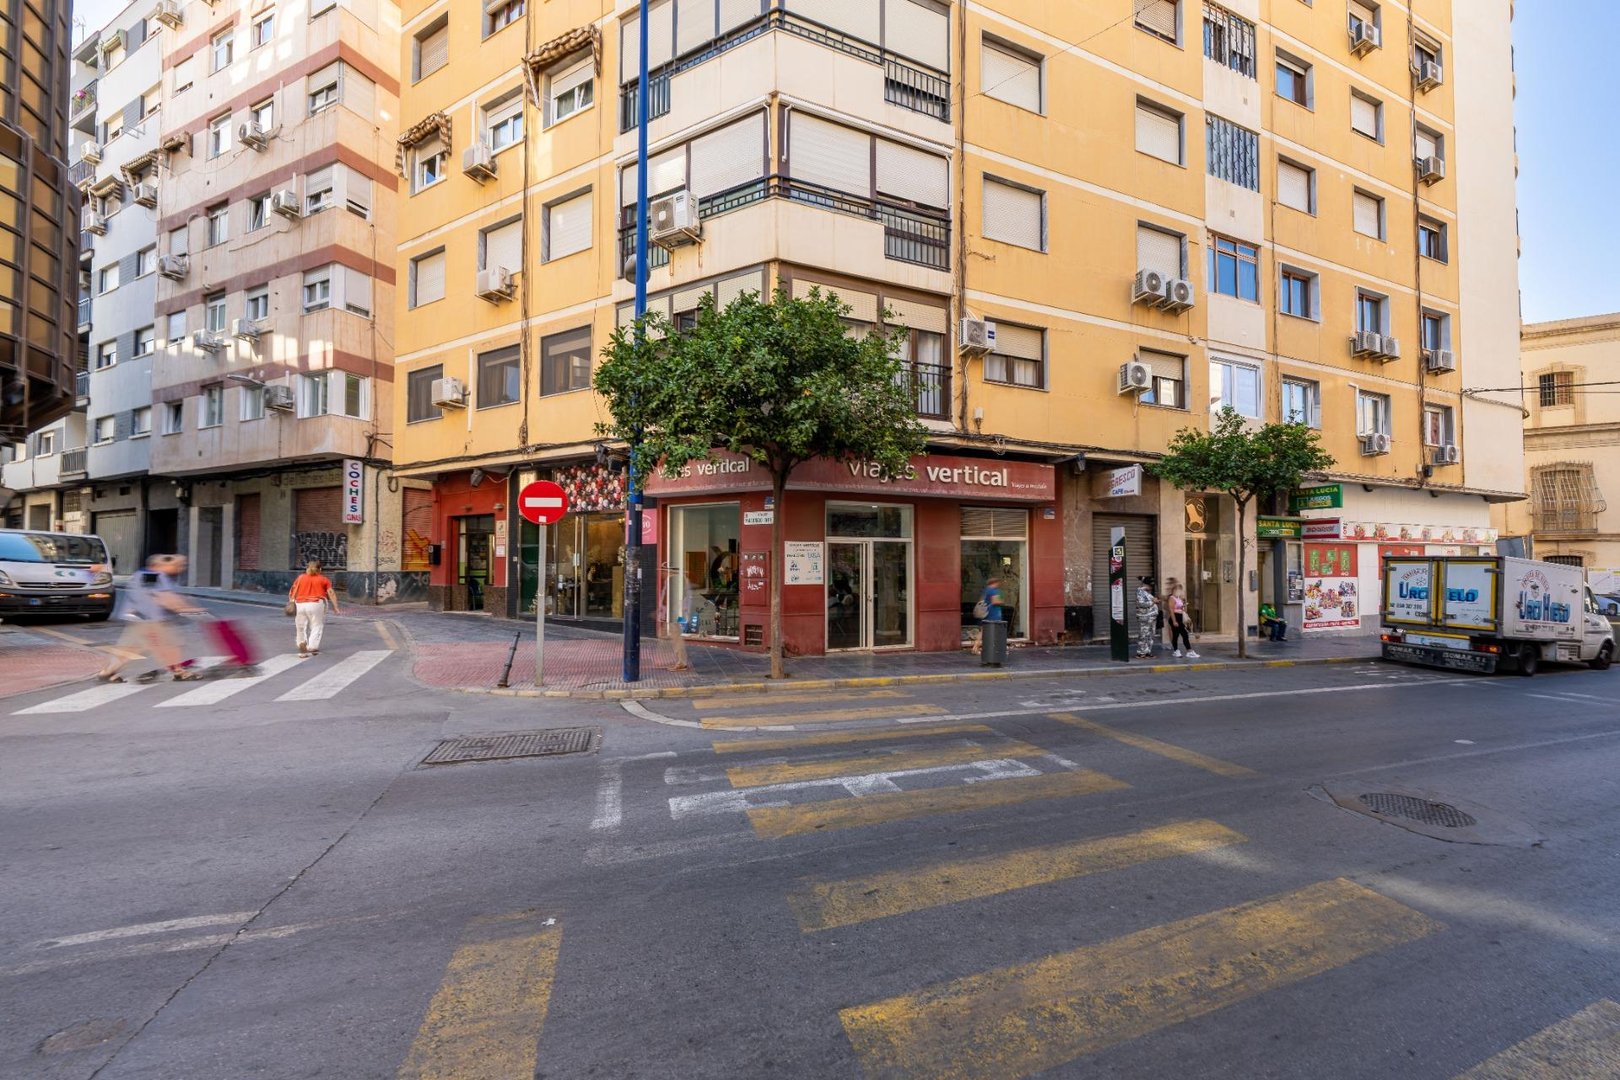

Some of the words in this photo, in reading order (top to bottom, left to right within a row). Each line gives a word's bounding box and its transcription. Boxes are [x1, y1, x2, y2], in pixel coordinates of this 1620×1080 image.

[697, 457, 750, 475] vertical
[926, 464, 1008, 487] vertical
[349, 462, 360, 512] COCHES
[1316, 486, 1338, 494] LUCIA
[1258, 520, 1280, 528] SANTA
[1282, 521, 1301, 529] LUCIA
